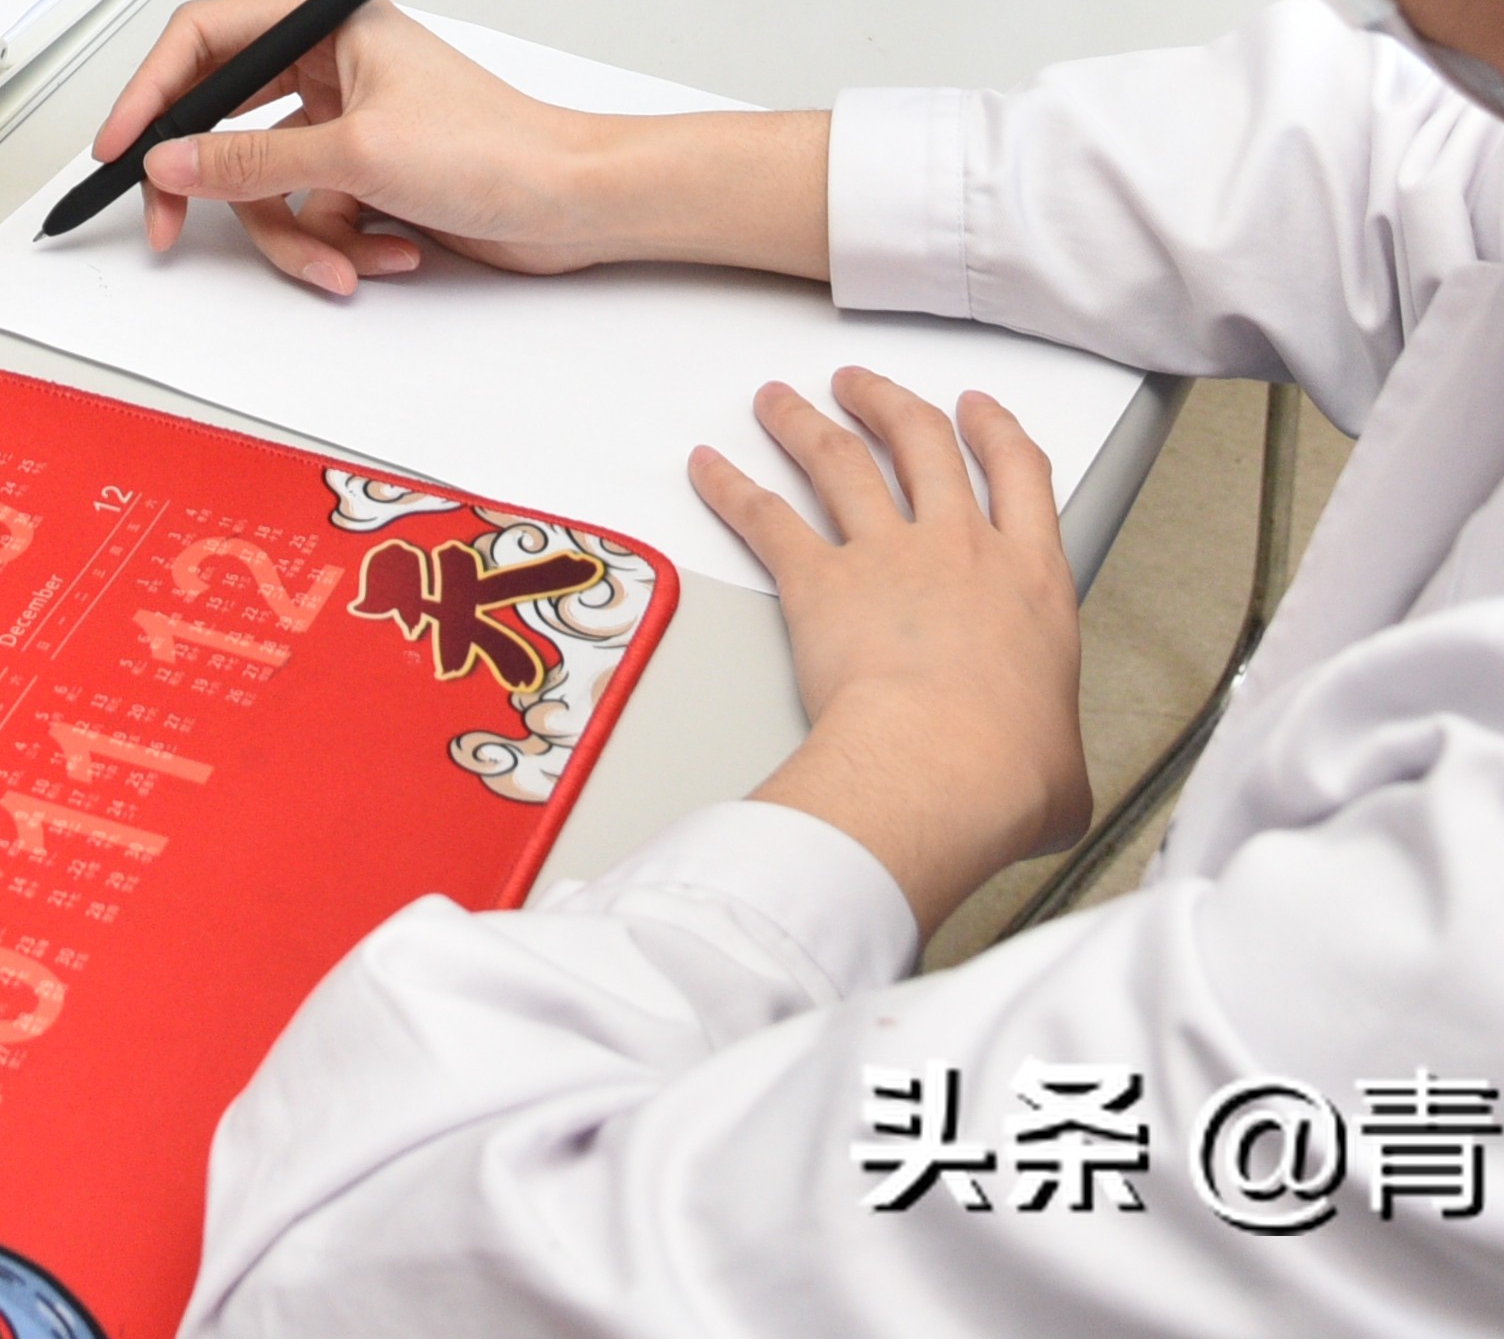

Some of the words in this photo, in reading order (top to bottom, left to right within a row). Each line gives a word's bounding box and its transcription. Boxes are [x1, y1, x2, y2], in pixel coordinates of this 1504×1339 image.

[91, 484, 134, 510] 12
[131, 540, 346, 667] 12
[0, 723, 214, 855] 11
